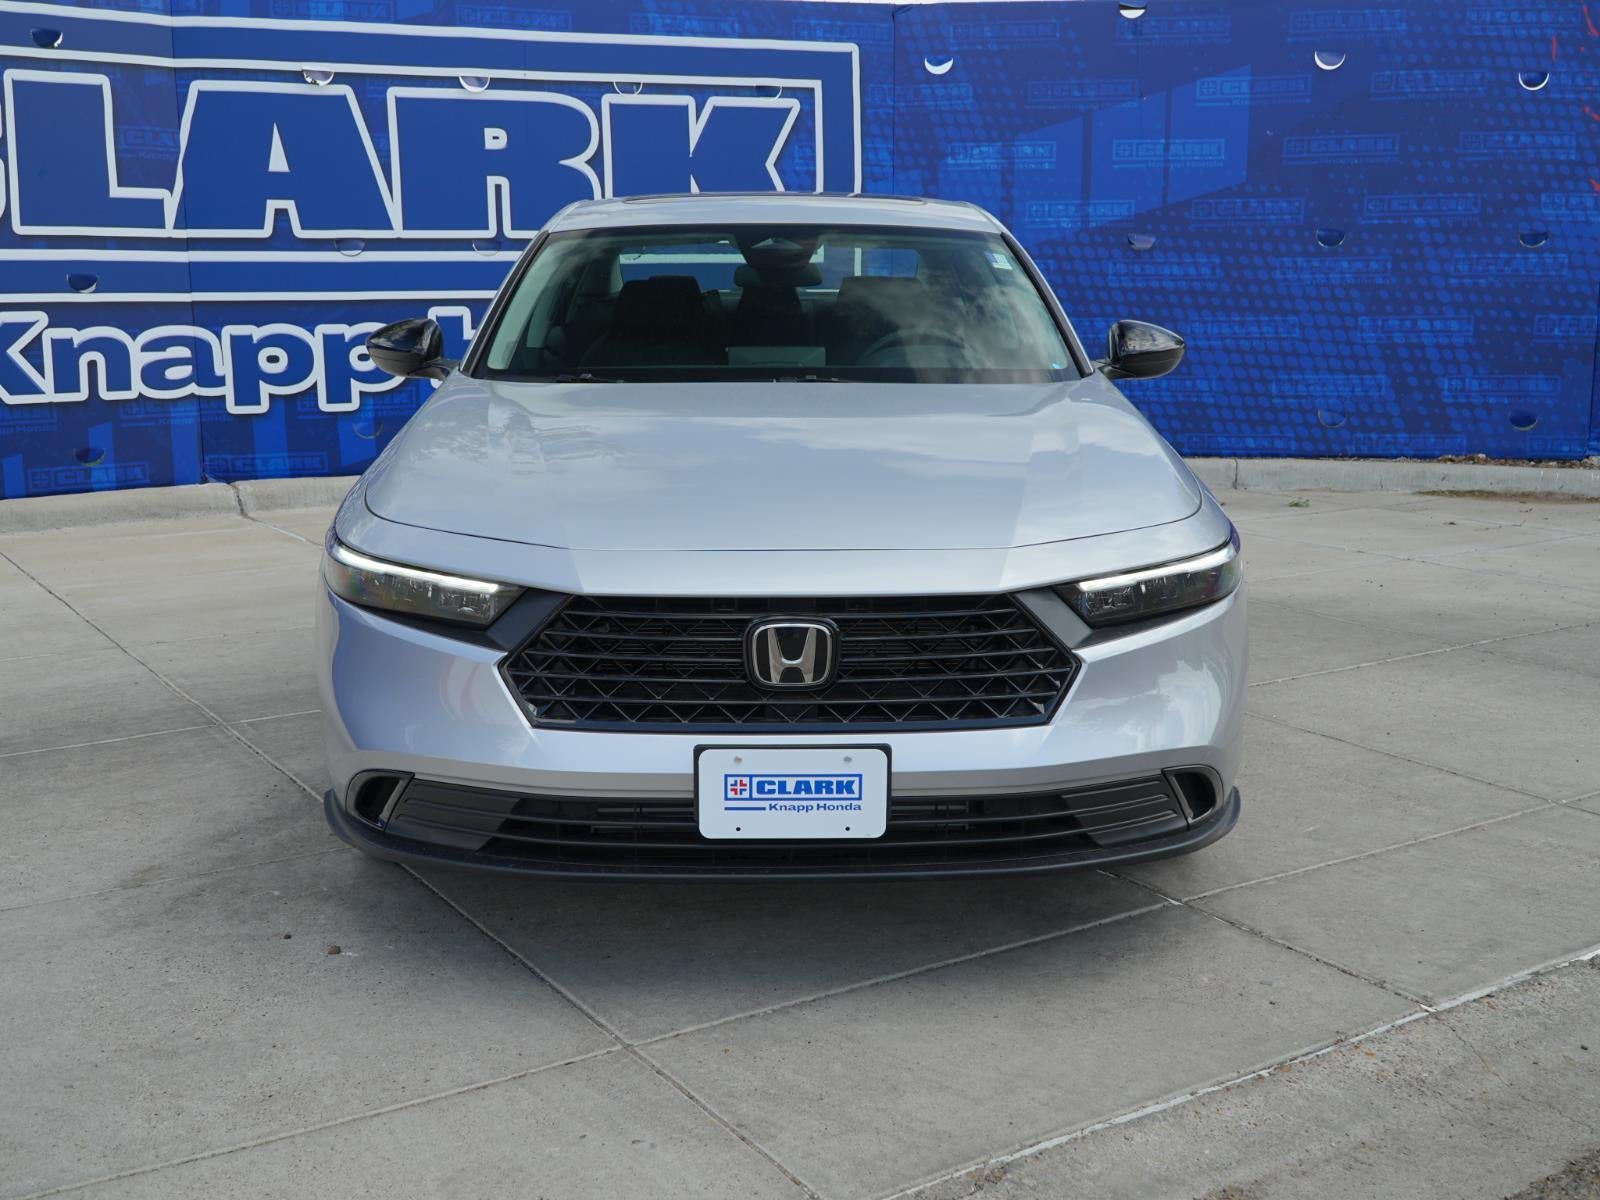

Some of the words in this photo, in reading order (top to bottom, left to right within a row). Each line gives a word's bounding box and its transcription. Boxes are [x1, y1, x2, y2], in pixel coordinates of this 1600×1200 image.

[0, 68, 800, 240] LARK
[755, 779, 856, 796] CLARK
[768, 802, 814, 813] Knapp
[816, 802, 862, 812] Honda
